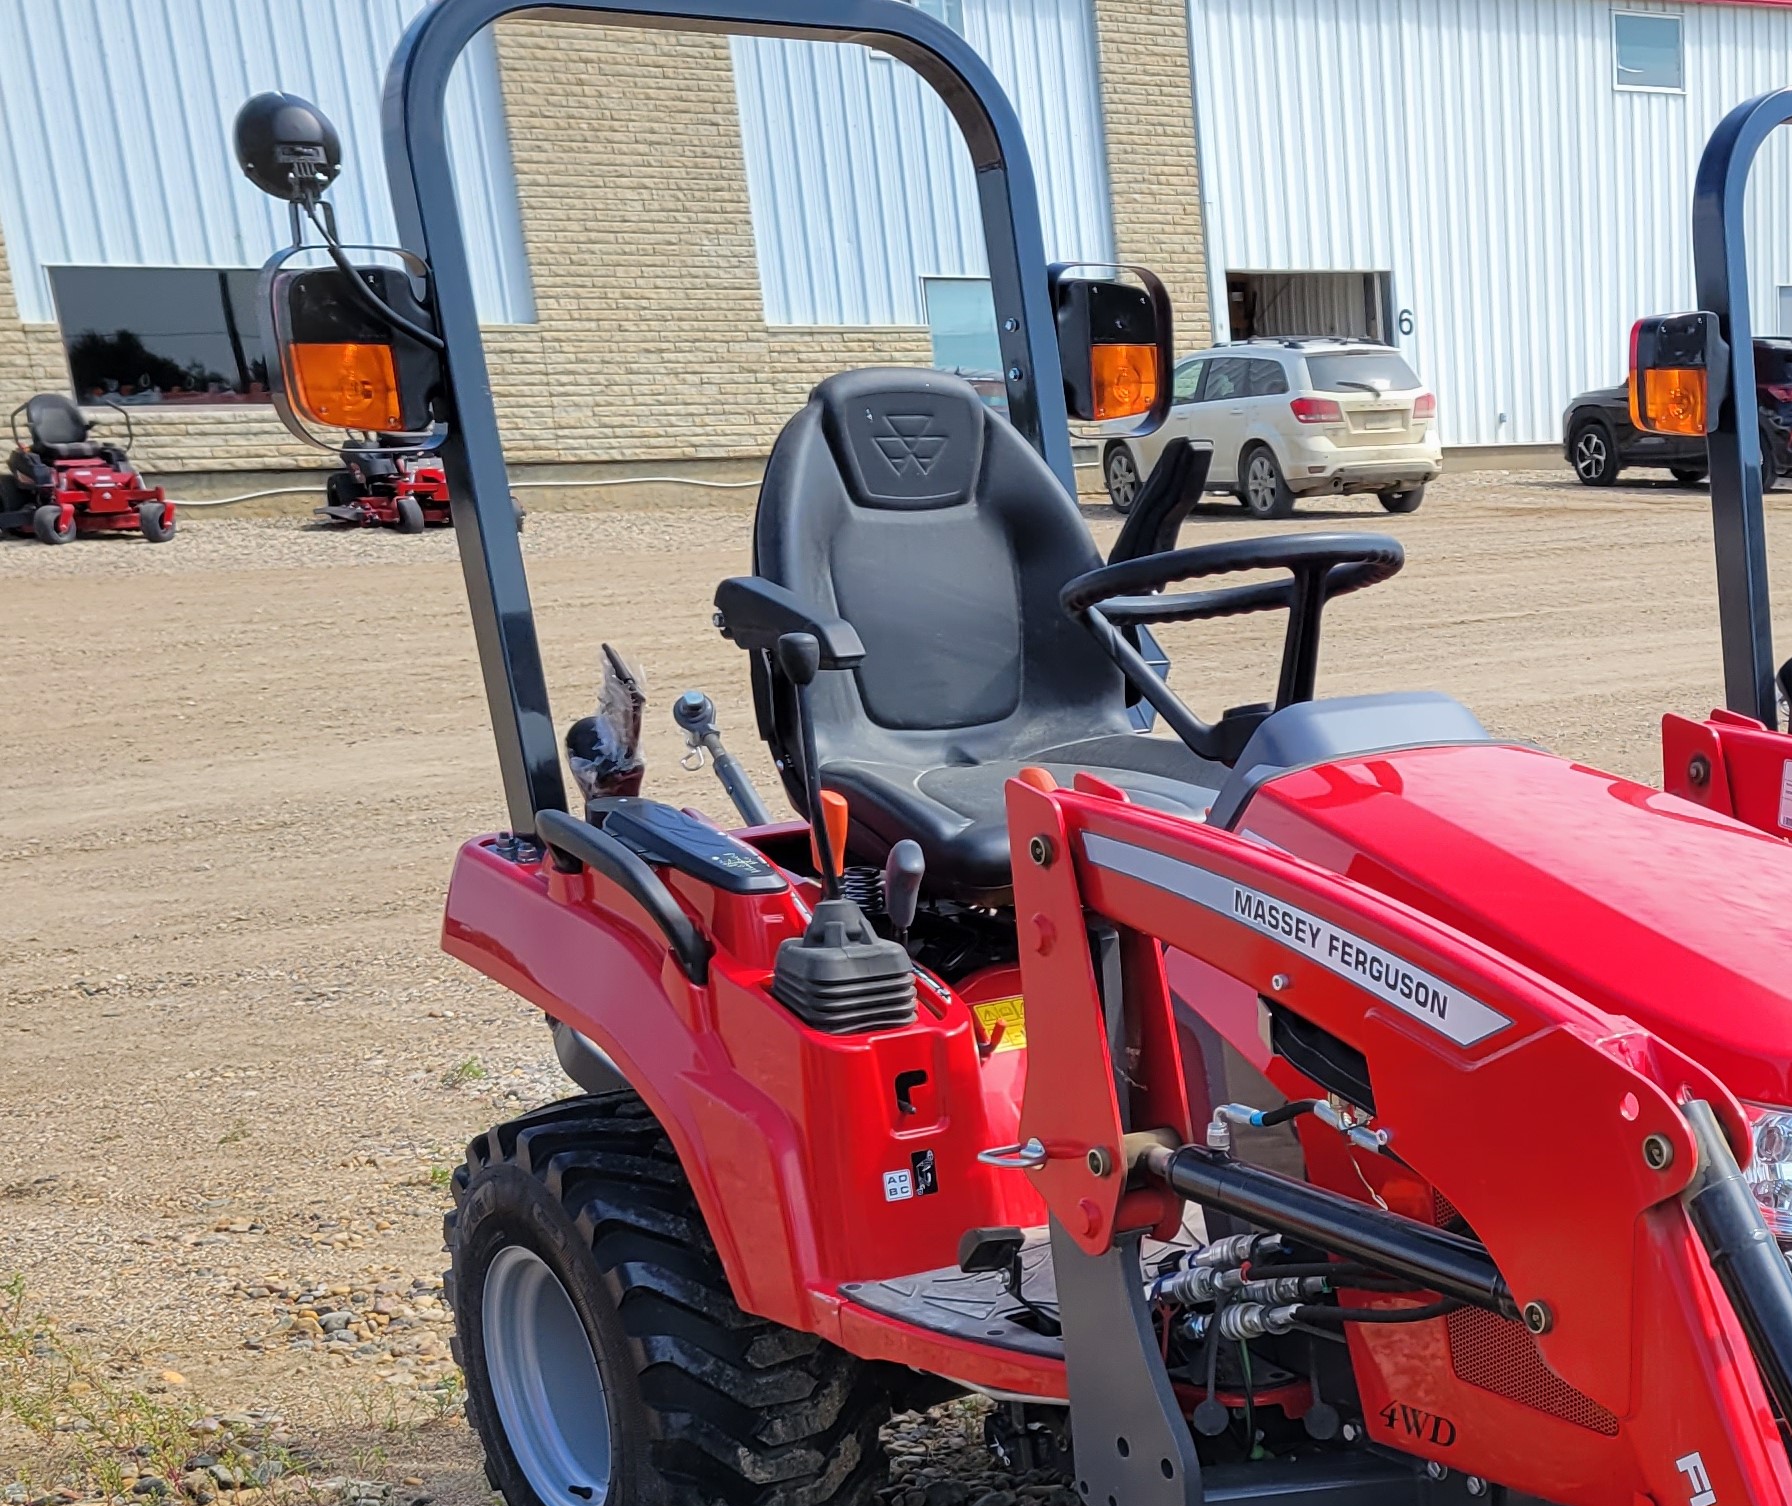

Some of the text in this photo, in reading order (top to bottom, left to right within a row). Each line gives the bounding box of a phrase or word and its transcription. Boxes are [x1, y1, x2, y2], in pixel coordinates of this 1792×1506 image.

[1399, 308, 1413, 335] 6
[1234, 888, 1449, 1020] MASSEY FERGUSON
[1379, 1400, 1457, 1447] 4WD
